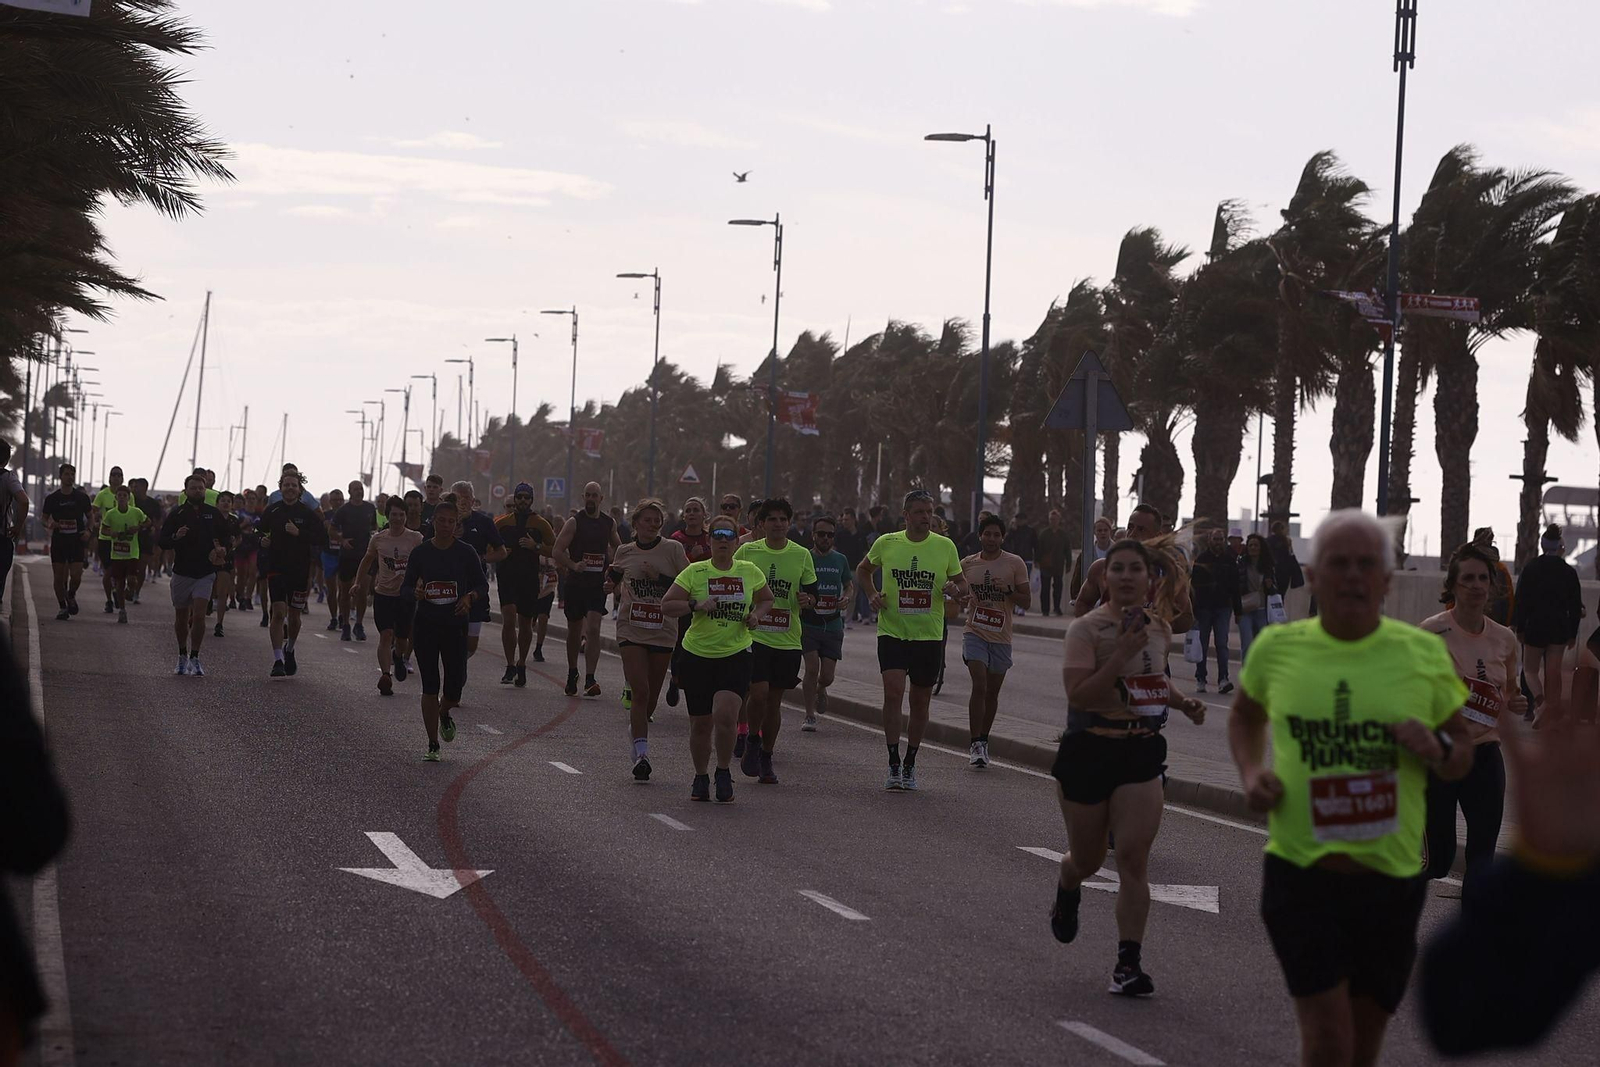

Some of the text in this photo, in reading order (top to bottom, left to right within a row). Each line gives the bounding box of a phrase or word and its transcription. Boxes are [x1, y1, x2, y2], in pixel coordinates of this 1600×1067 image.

[891, 569, 935, 581] BRUNCH
[630, 578, 656, 591] BRUN
[768, 579, 792, 591] NCH
[817, 583, 838, 591] ÁLAGA
[897, 577, 917, 590] RUN
[634, 587, 654, 599] RUN
[716, 601, 747, 612] UNCH
[648, 612, 661, 620] 651
[774, 616, 787, 624] 650
[1147, 688, 1168, 700] 1530
[1477, 695, 1500, 711] 1128
[1285, 714, 1397, 746] BRUNCH
[1301, 739, 1355, 771] RUN
[1356, 792, 1394, 814] 1601
